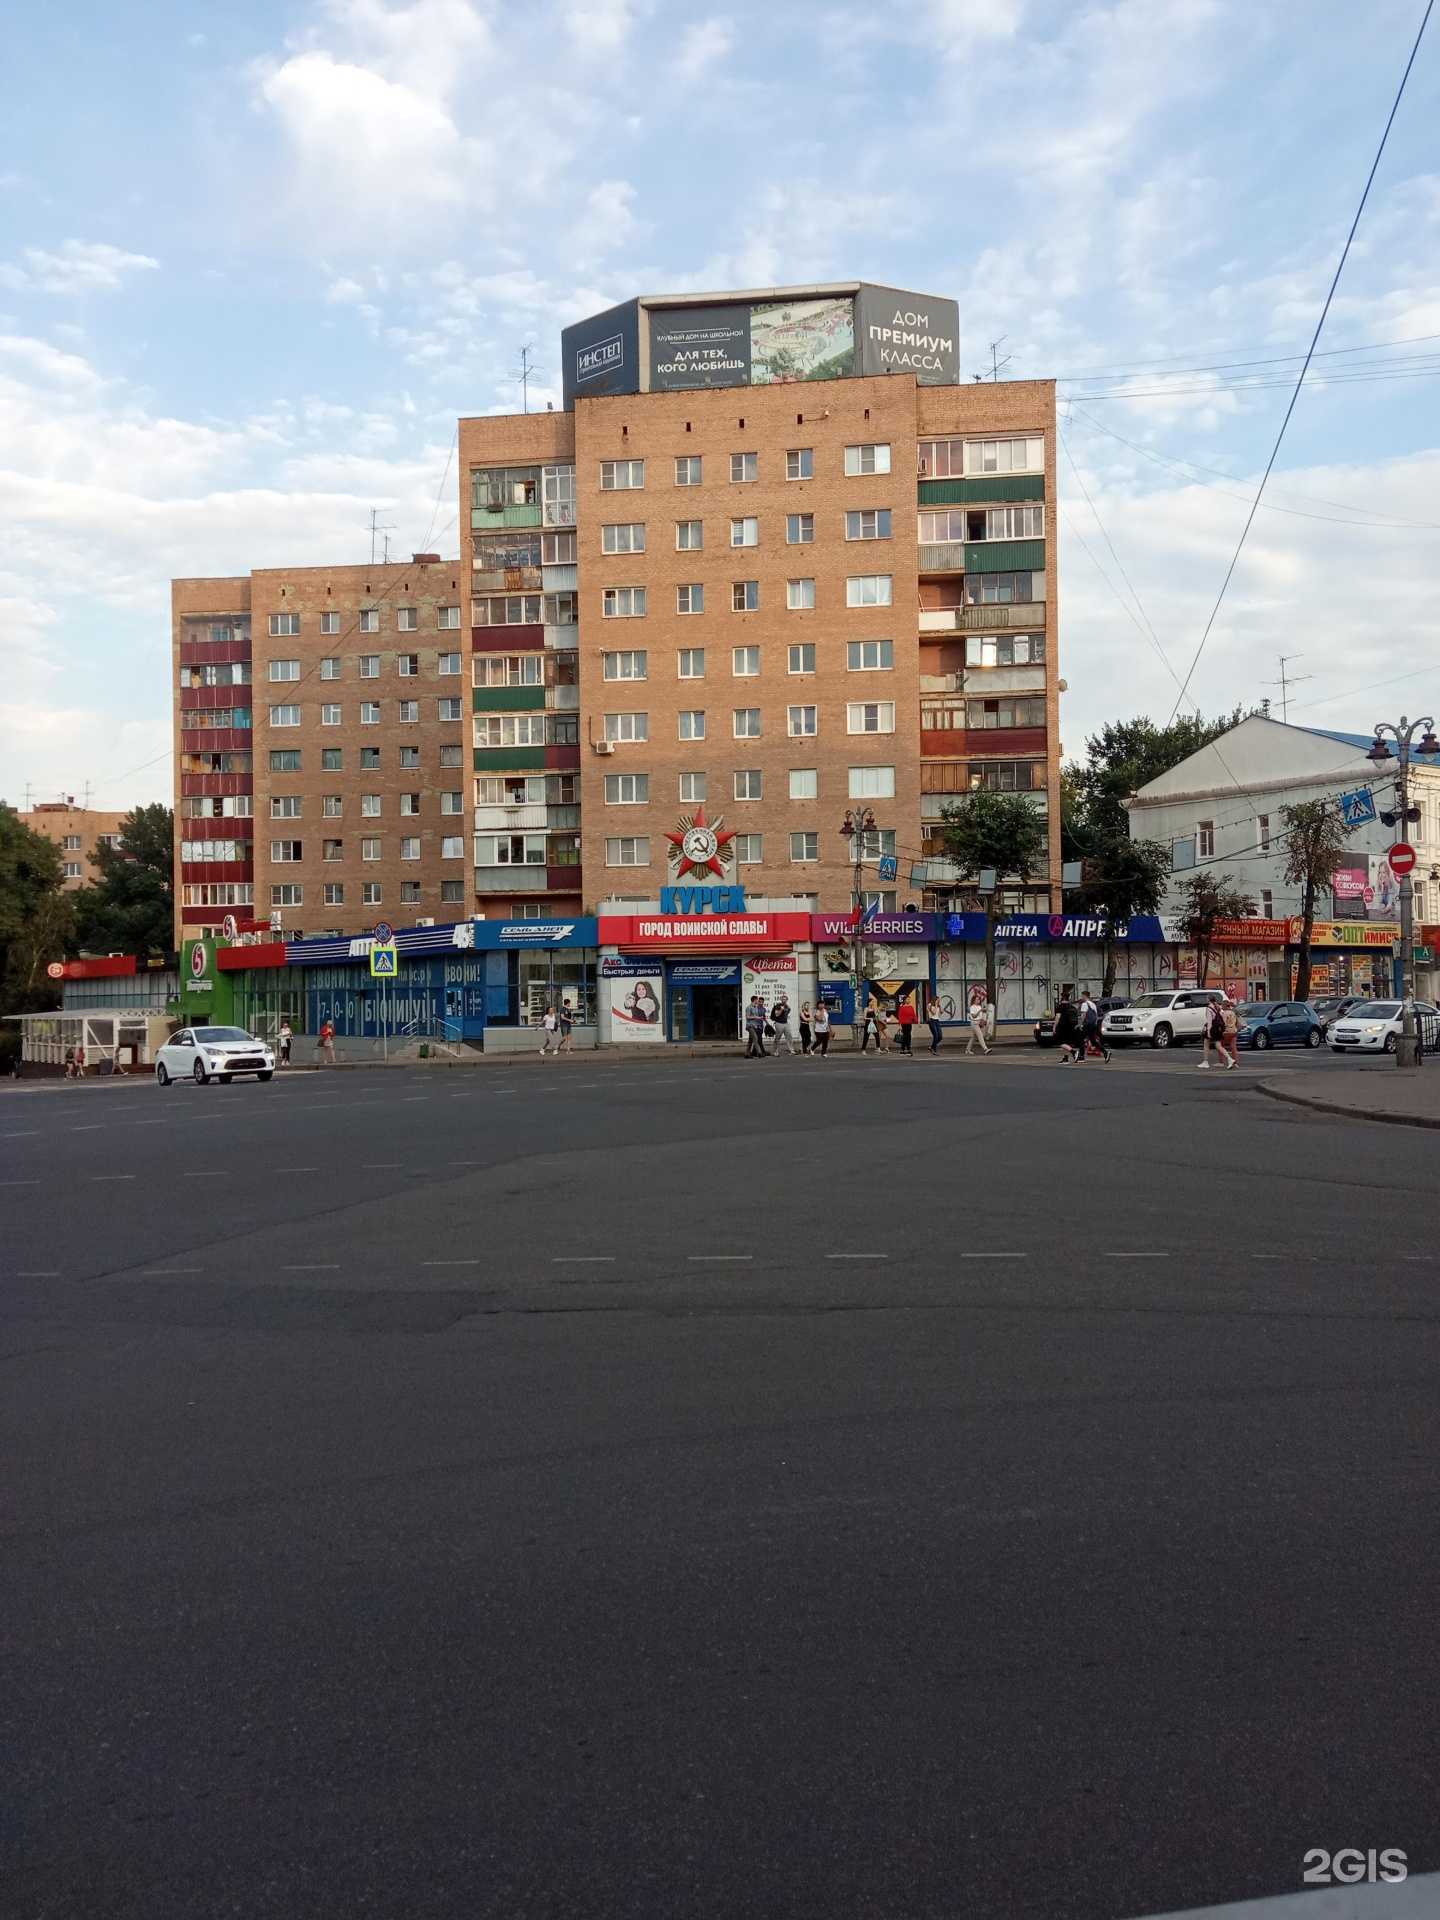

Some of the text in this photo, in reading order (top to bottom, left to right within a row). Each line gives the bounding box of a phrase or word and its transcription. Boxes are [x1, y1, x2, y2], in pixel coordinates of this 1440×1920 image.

[892, 310, 929, 329] ДОМ
[869, 325, 953, 353] ПРЕМИУМ
[675, 348, 728, 362] ДЛЯ ТЕХ,
[880, 347, 944, 371] КЛАССА
[657, 359, 745, 373] КОГО ЛЮБИШЬ
[660, 885, 747, 914] КУРСК
[639, 919, 768, 937] ГОРОД ВОИНСКОЙ СЛАВЫ
[824, 920, 924, 935] WILBERRIES
[994, 925, 1038, 937] АПТЕКА
[1251, 925, 1285, 937] МАГАЗИН
